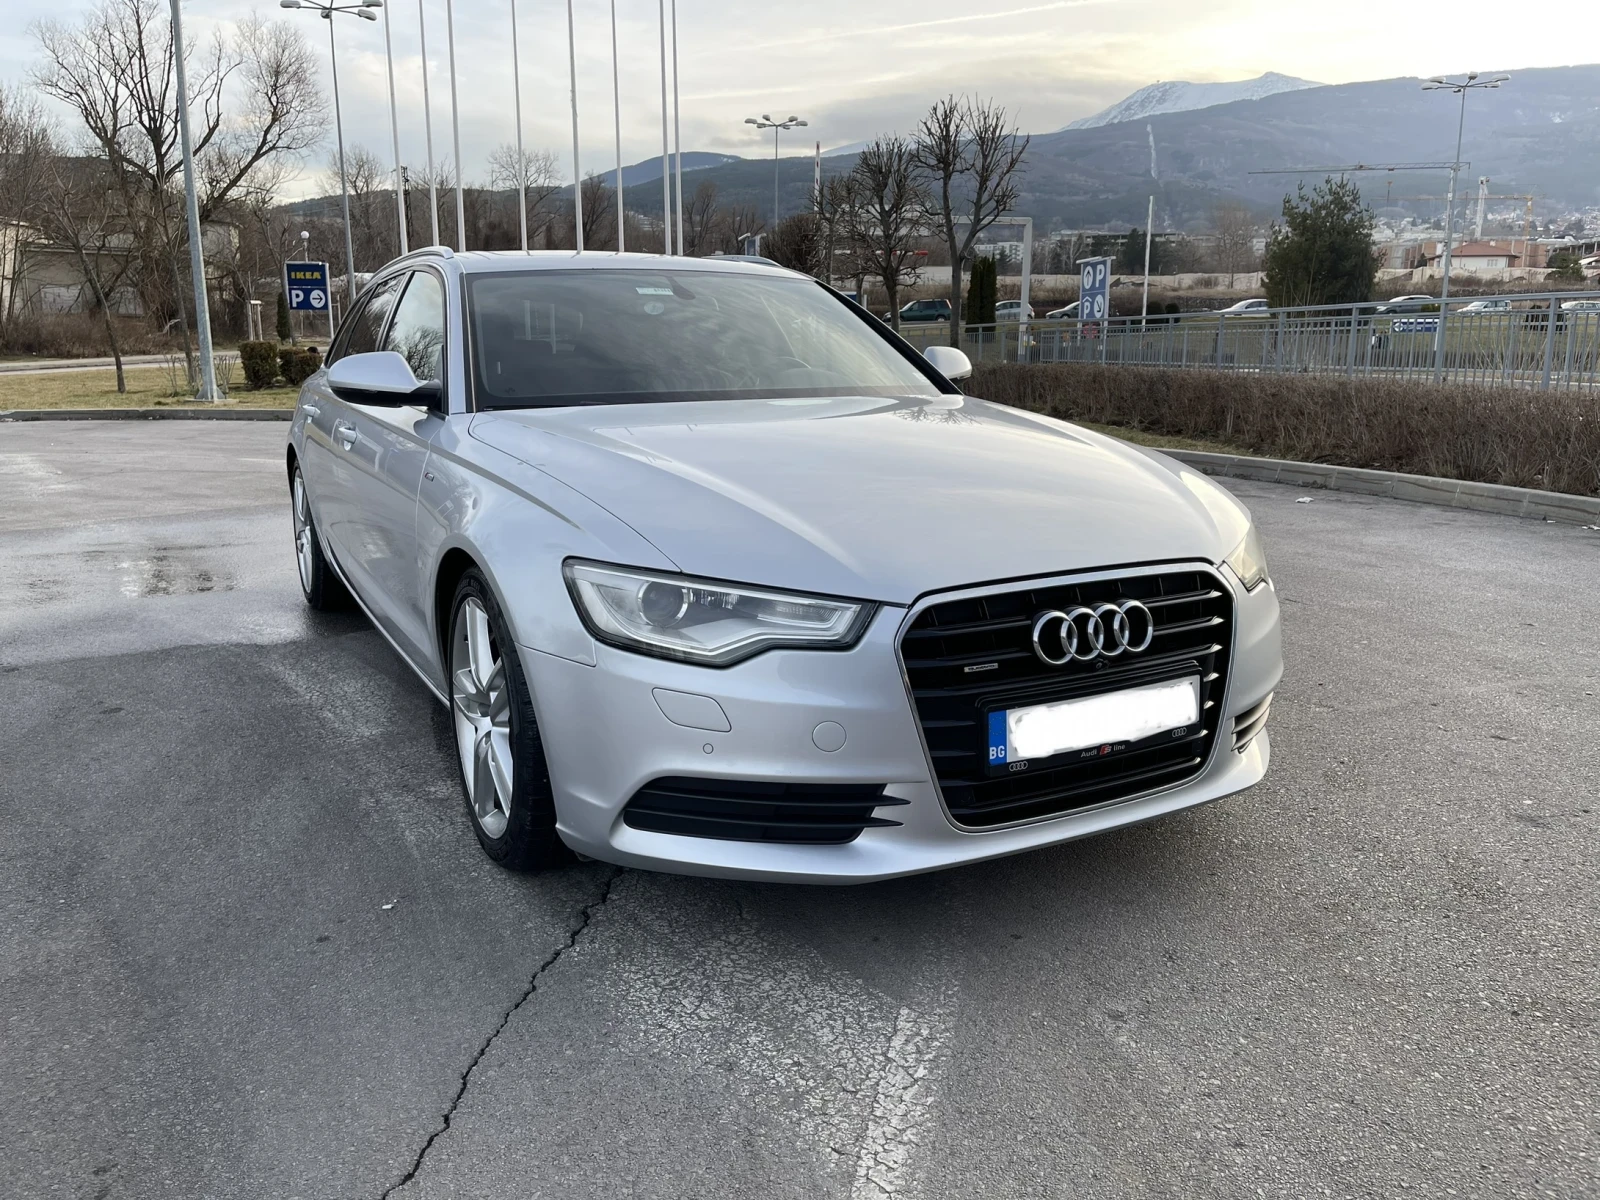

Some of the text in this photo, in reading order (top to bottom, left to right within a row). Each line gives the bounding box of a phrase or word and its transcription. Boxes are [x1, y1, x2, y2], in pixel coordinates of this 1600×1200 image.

[1095, 264, 1105, 288] P
[291, 290, 304, 308] P
[989, 745, 1005, 760] BG
[1080, 748, 1098, 758] Audi
[1113, 744, 1126, 752] line
